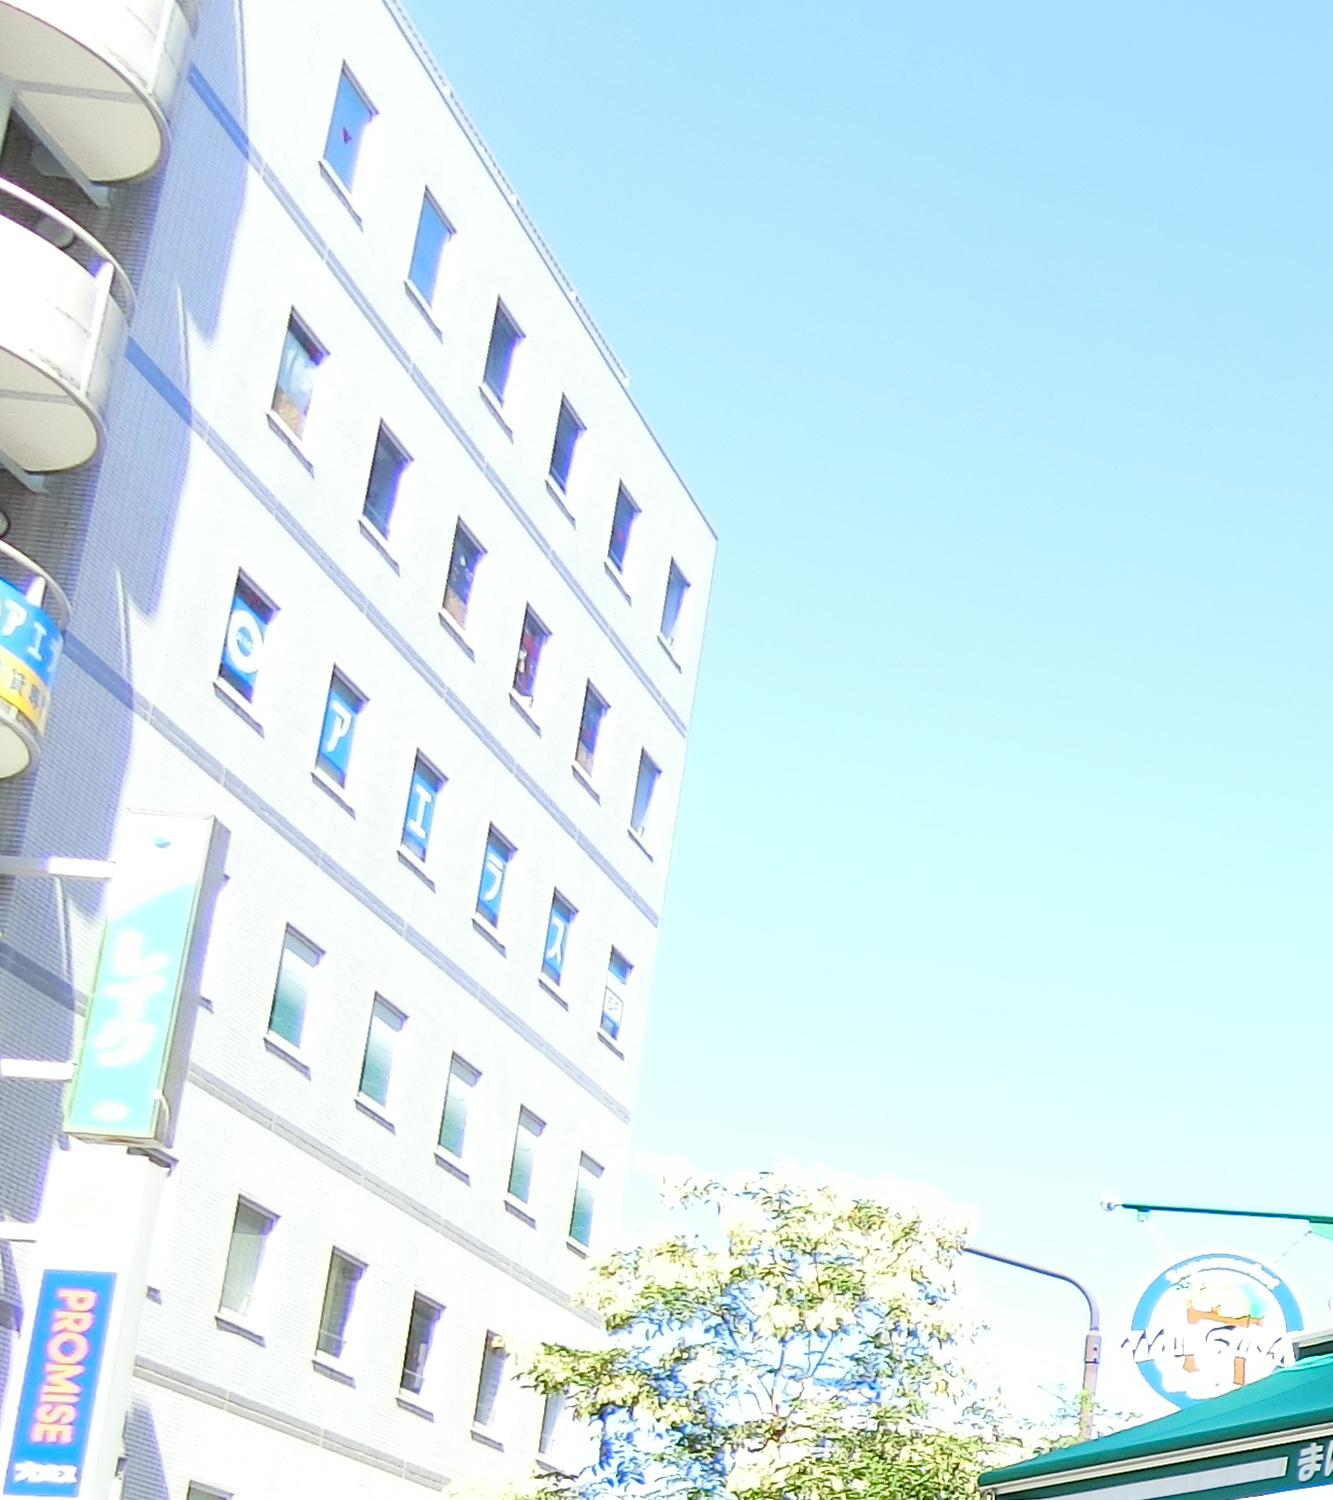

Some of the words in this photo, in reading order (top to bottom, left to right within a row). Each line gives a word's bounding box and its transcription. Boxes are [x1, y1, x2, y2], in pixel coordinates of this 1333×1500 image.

[95, 928, 172, 1067] レイク
[30, 1286, 98, 1443] PROMISE
